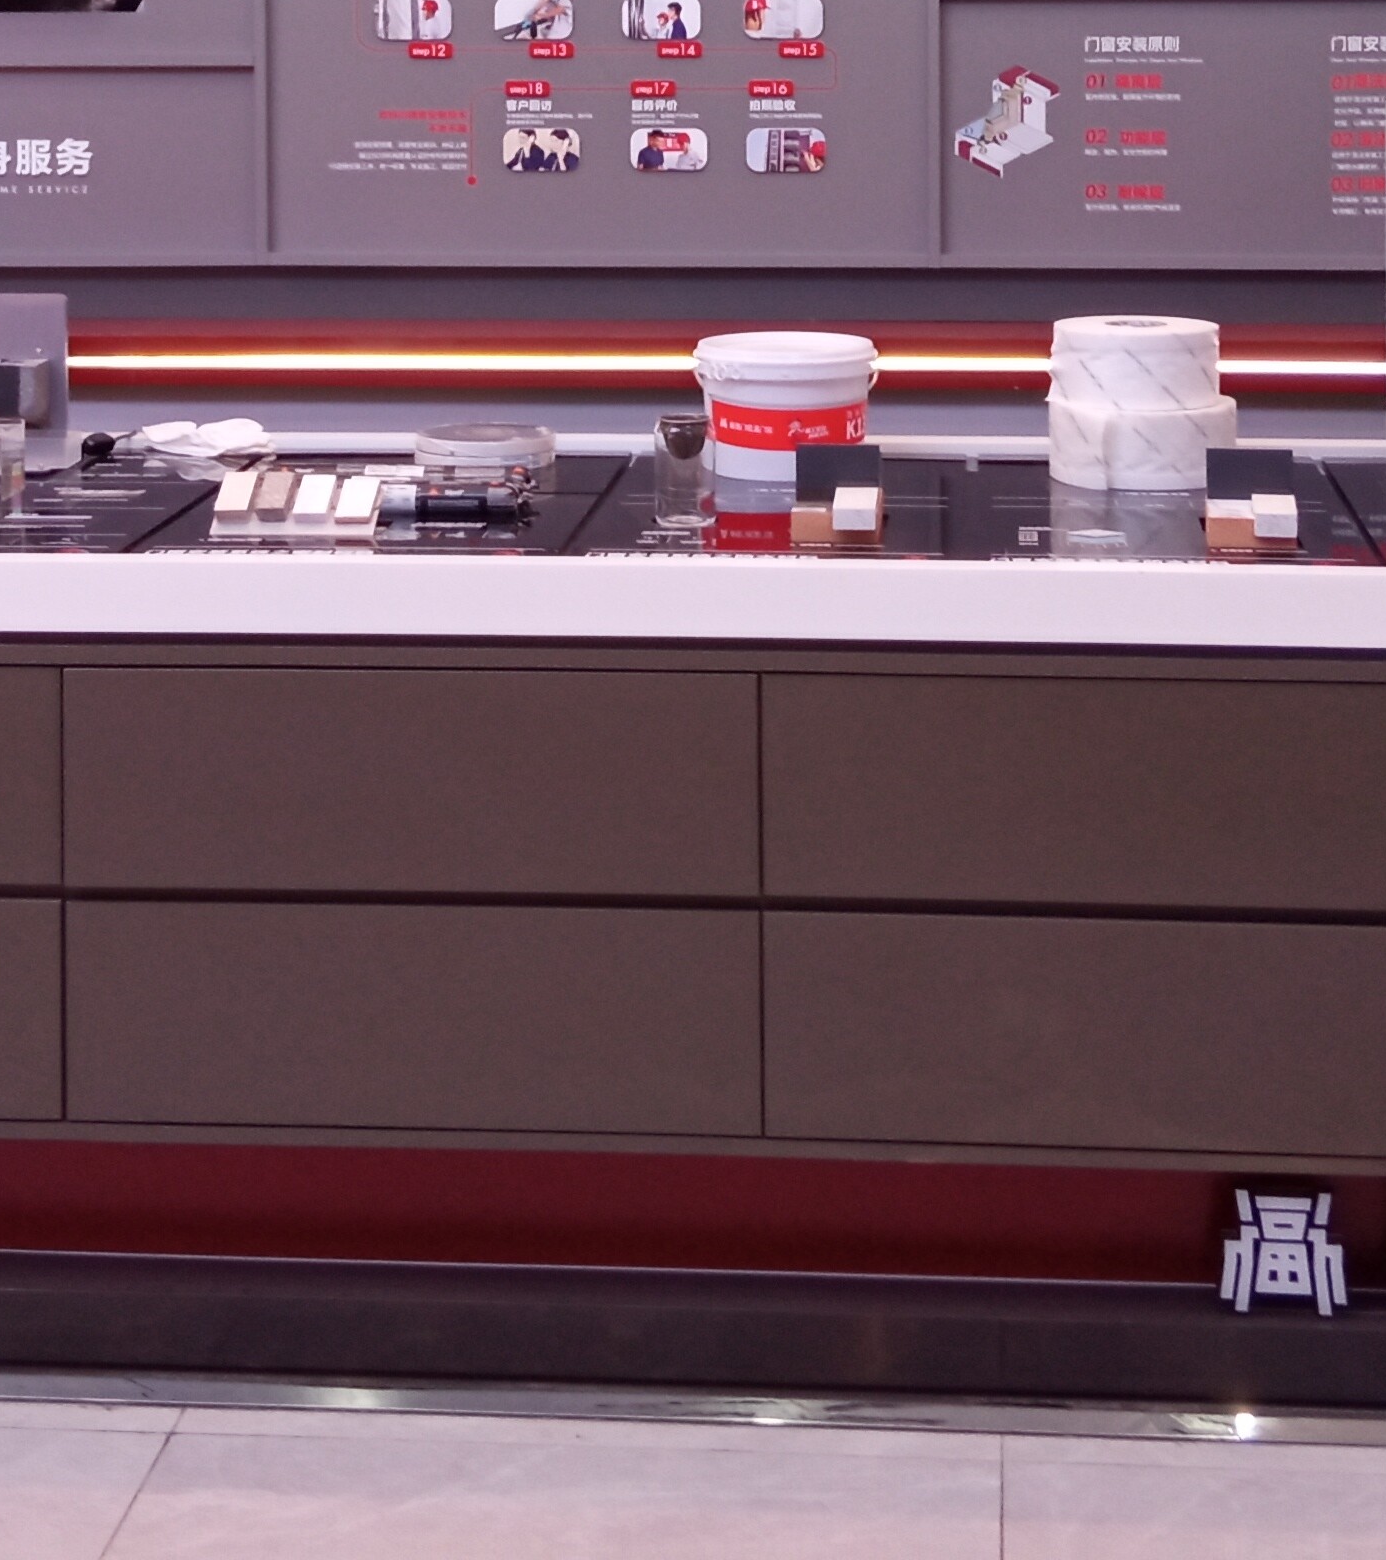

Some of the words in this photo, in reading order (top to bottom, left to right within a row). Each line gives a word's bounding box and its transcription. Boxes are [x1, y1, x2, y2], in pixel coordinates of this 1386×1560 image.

[1084, 35, 1180, 53] 门窗安装原则
